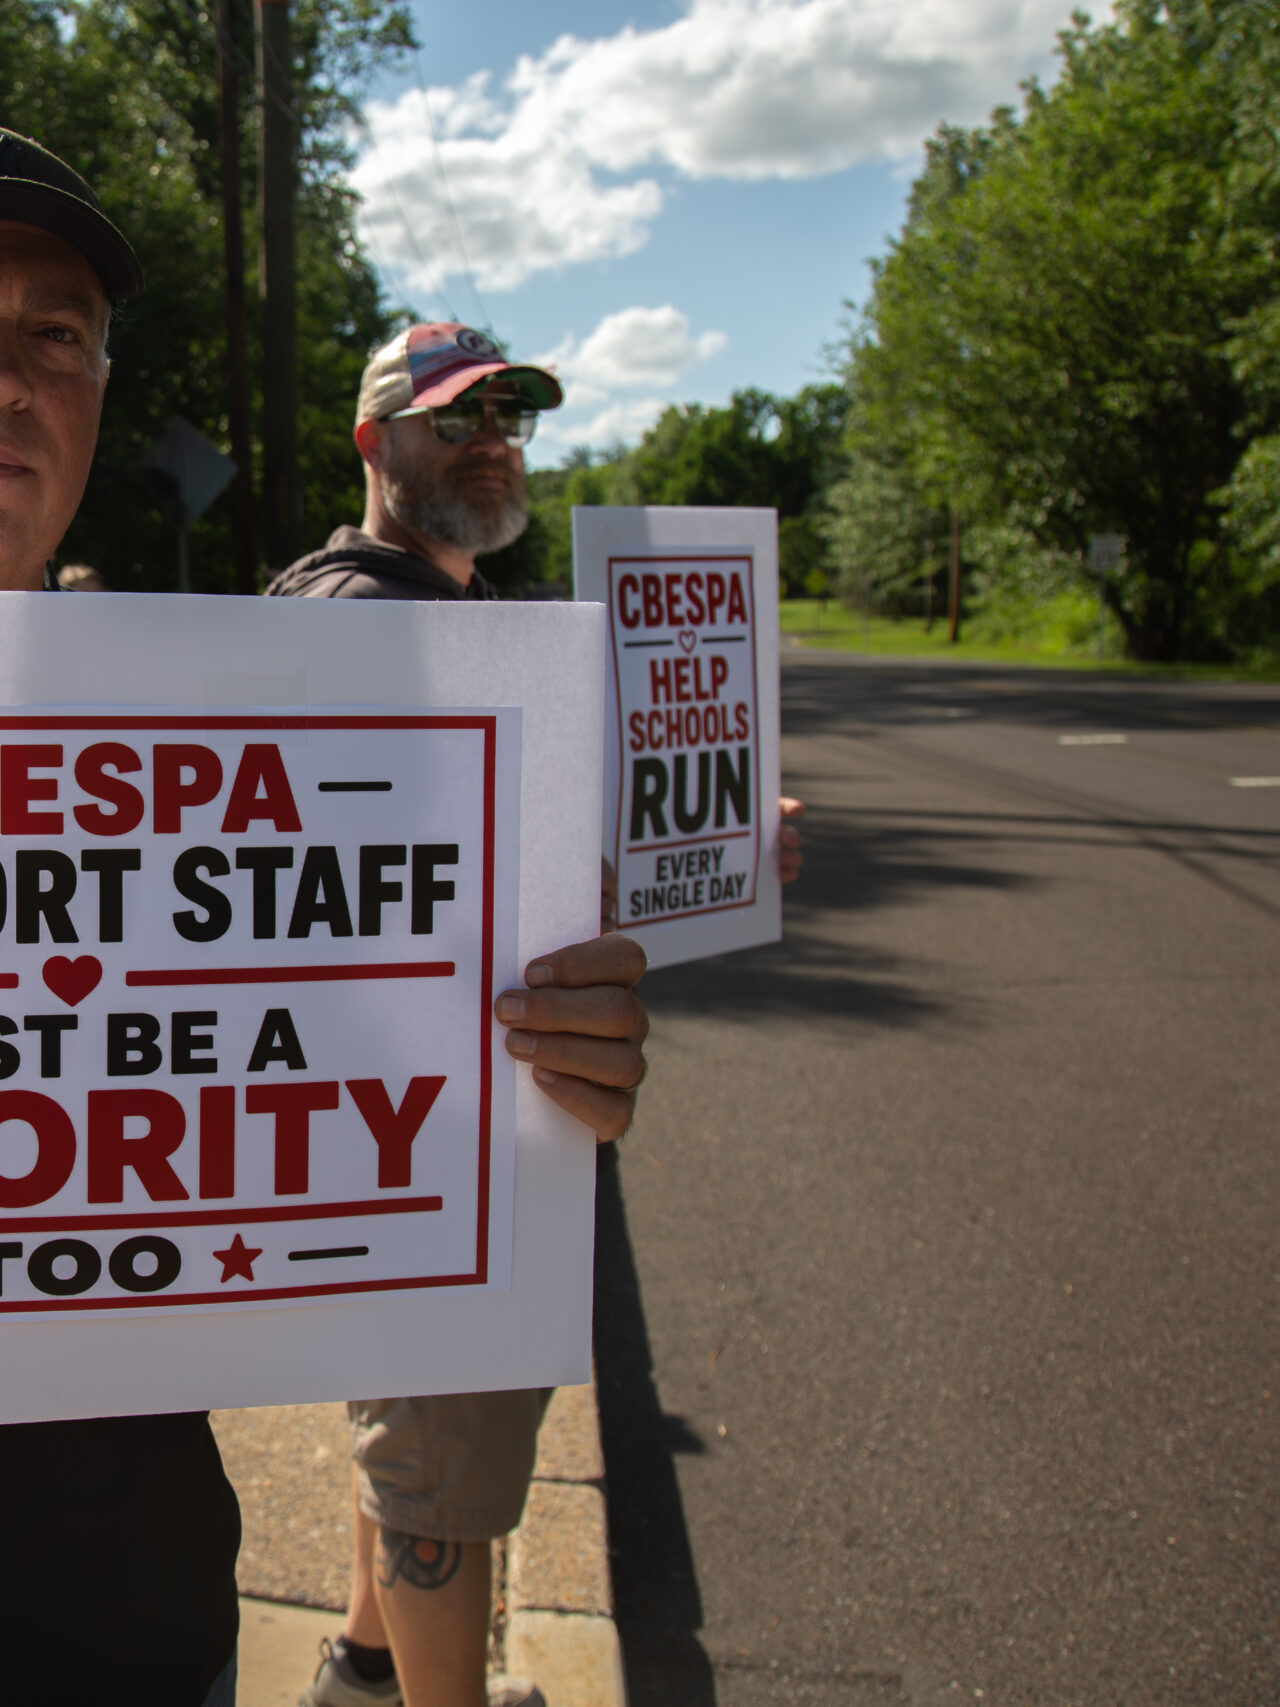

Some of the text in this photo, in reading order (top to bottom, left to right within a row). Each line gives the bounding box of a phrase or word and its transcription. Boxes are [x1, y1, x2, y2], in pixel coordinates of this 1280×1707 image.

[618, 571, 748, 630] CBESPA
[649, 655, 729, 705] HELP
[629, 702, 750, 753] SCHOOLS
[629, 747, 751, 841] RUN
[655, 846, 726, 883] EVERY
[172, 843, 460, 943] STAFF
[630, 872, 747, 917] SINGLE DAY
[106, 1010, 219, 1077] BE
[246, 1008, 307, 1072] A
